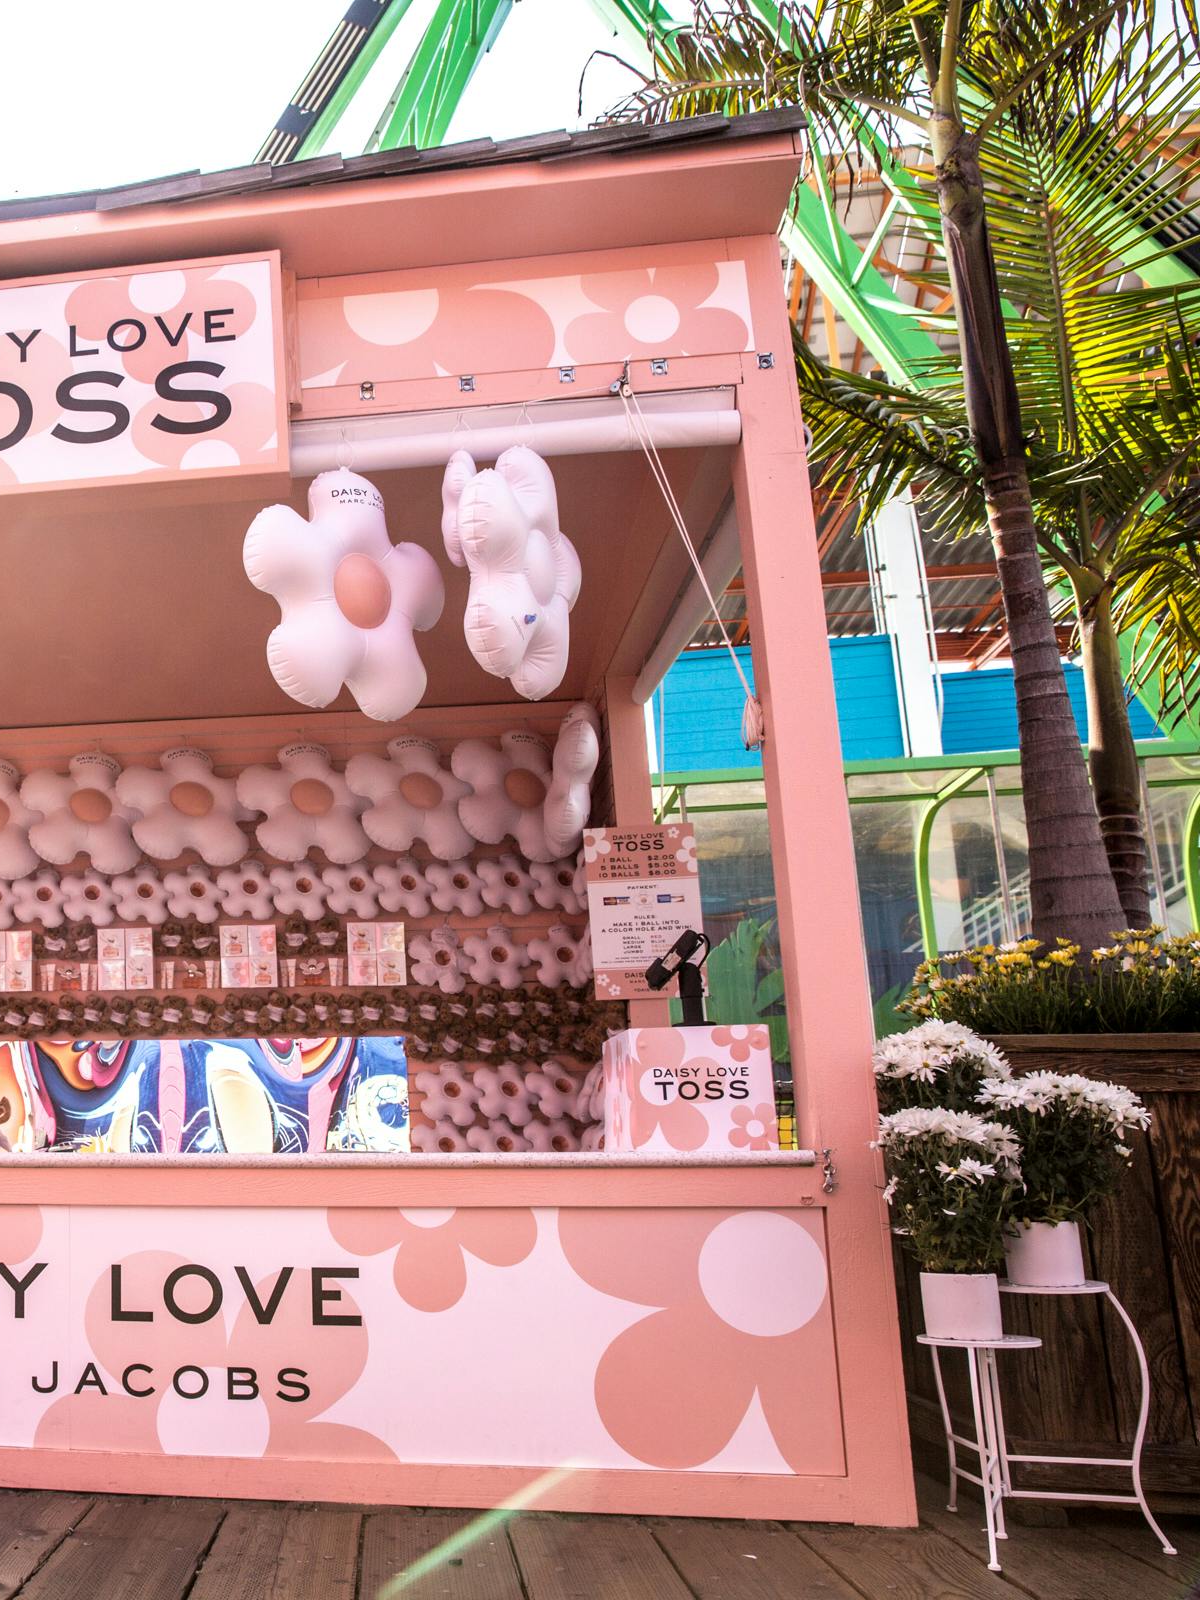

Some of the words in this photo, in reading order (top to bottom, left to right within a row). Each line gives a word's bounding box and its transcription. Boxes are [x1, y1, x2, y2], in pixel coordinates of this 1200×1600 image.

[69, 308, 236, 357] LOVE
[331, 489, 367, 497] DAISY
[613, 840, 664, 851] TOSS
[653, 1068, 700, 1078] DAISY
[706, 1067, 750, 1077] LOVE
[654, 1080, 750, 1100] TOSS
[110, 1264, 362, 1327] LOVE
[32, 1360, 311, 1402] JACOBS
